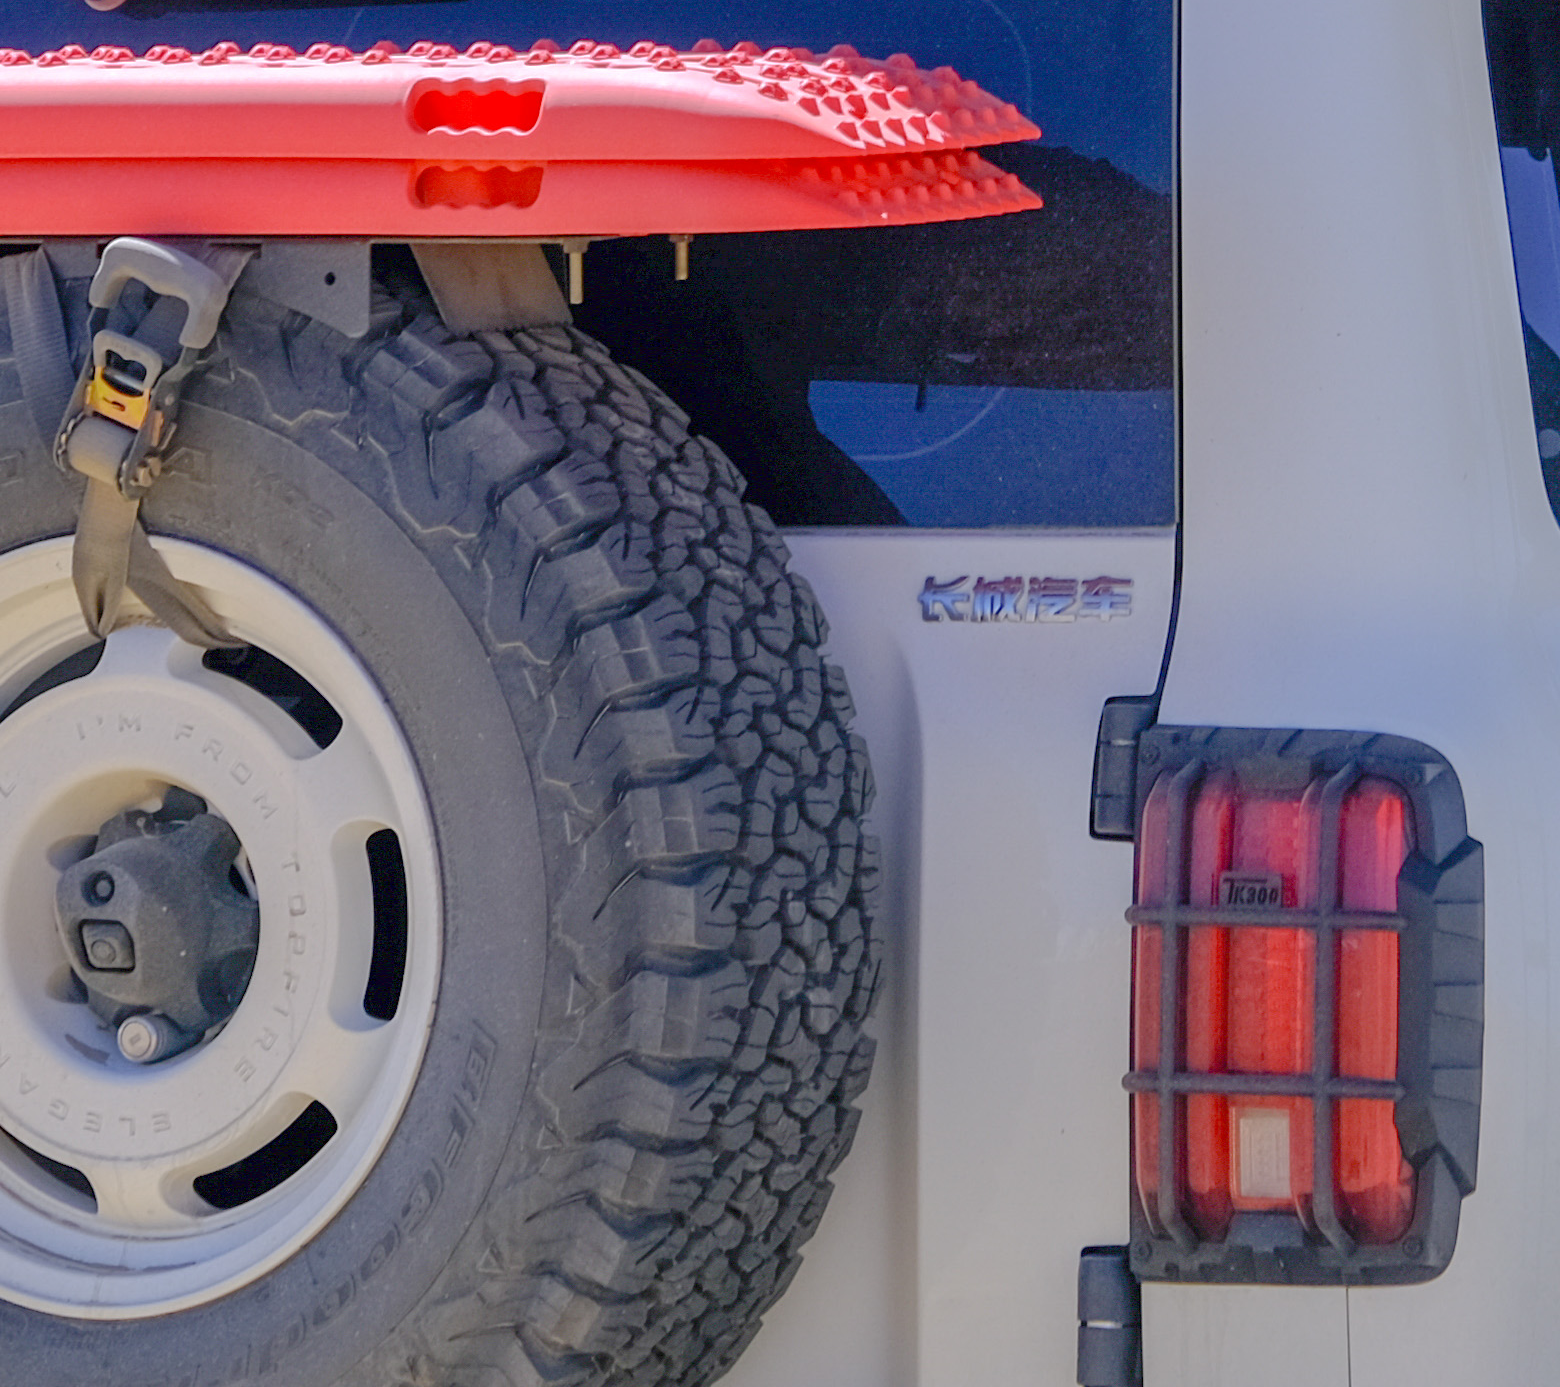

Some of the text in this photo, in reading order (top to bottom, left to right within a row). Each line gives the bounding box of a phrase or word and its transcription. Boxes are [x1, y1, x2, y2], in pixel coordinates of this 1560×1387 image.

[916, 575, 1135, 624] 长城汽车
[76, 715, 308, 1083] I'M FROM TOPFIRE
